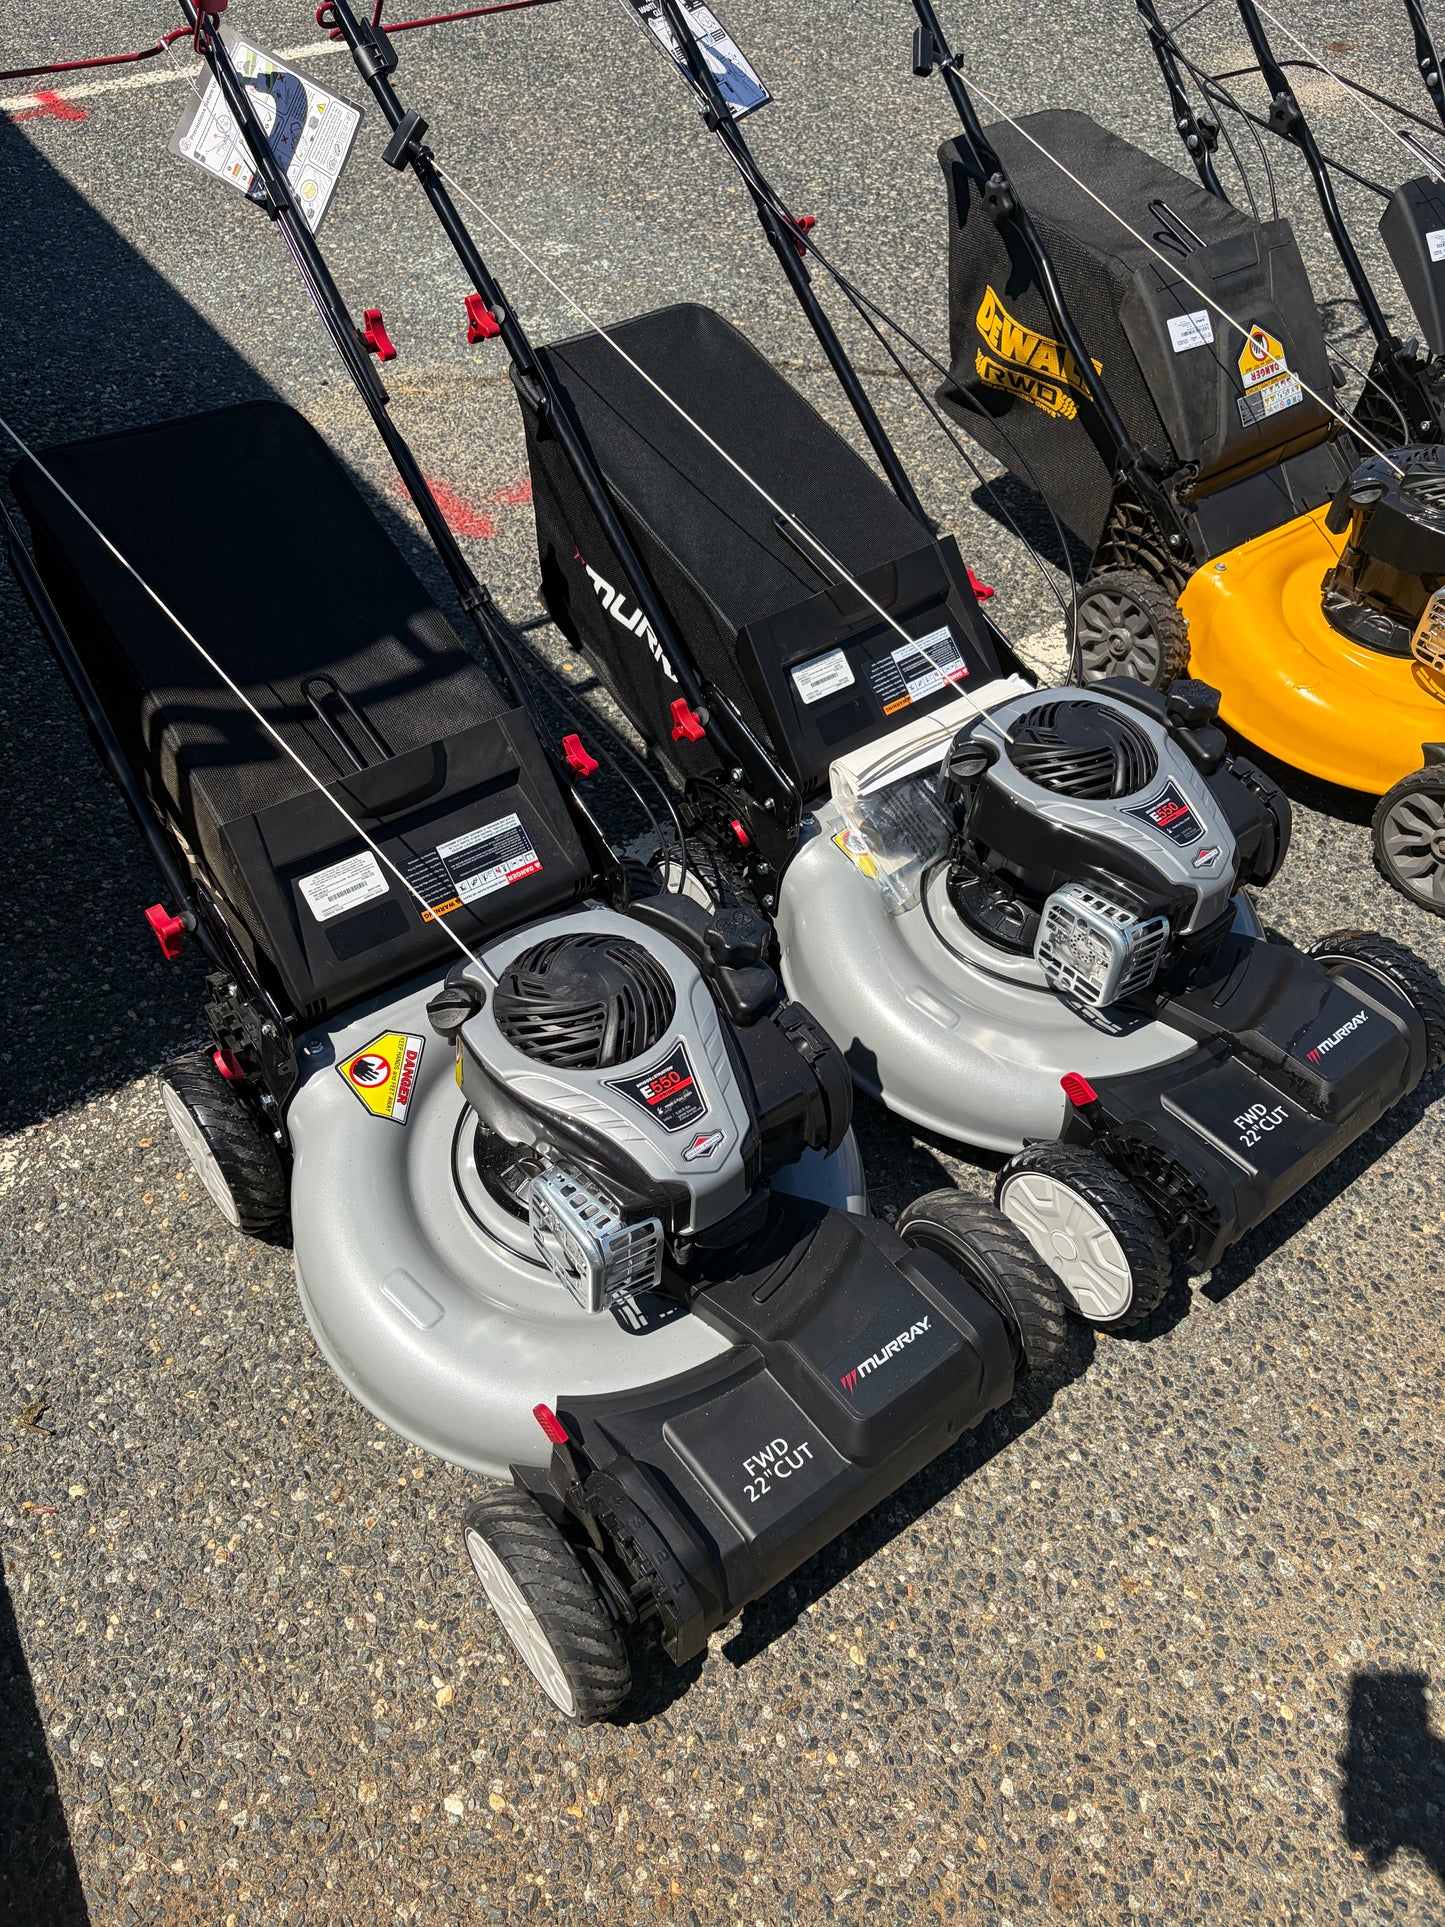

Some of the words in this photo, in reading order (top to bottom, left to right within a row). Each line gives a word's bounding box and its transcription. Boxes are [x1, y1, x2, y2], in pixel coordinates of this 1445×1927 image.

[976, 287, 1102, 398] DEWAL
[984, 362, 1058, 404] RWD
[1251, 362, 1280, 381] DANGER
[1149, 801, 1179, 823] E550
[508, 865, 535, 882] DANGER
[1316, 1010, 1368, 1055] MURRAY
[394, 1050, 402, 1070] HANDS
[396, 1049, 418, 1106] DANGER
[639, 1070, 681, 1100] E550
[386, 1096, 394, 1112] AWAY
[1233, 1103, 1267, 1130] FWD
[857, 1315, 931, 1378] MURRAY
[742, 1438, 788, 1477] FWD
